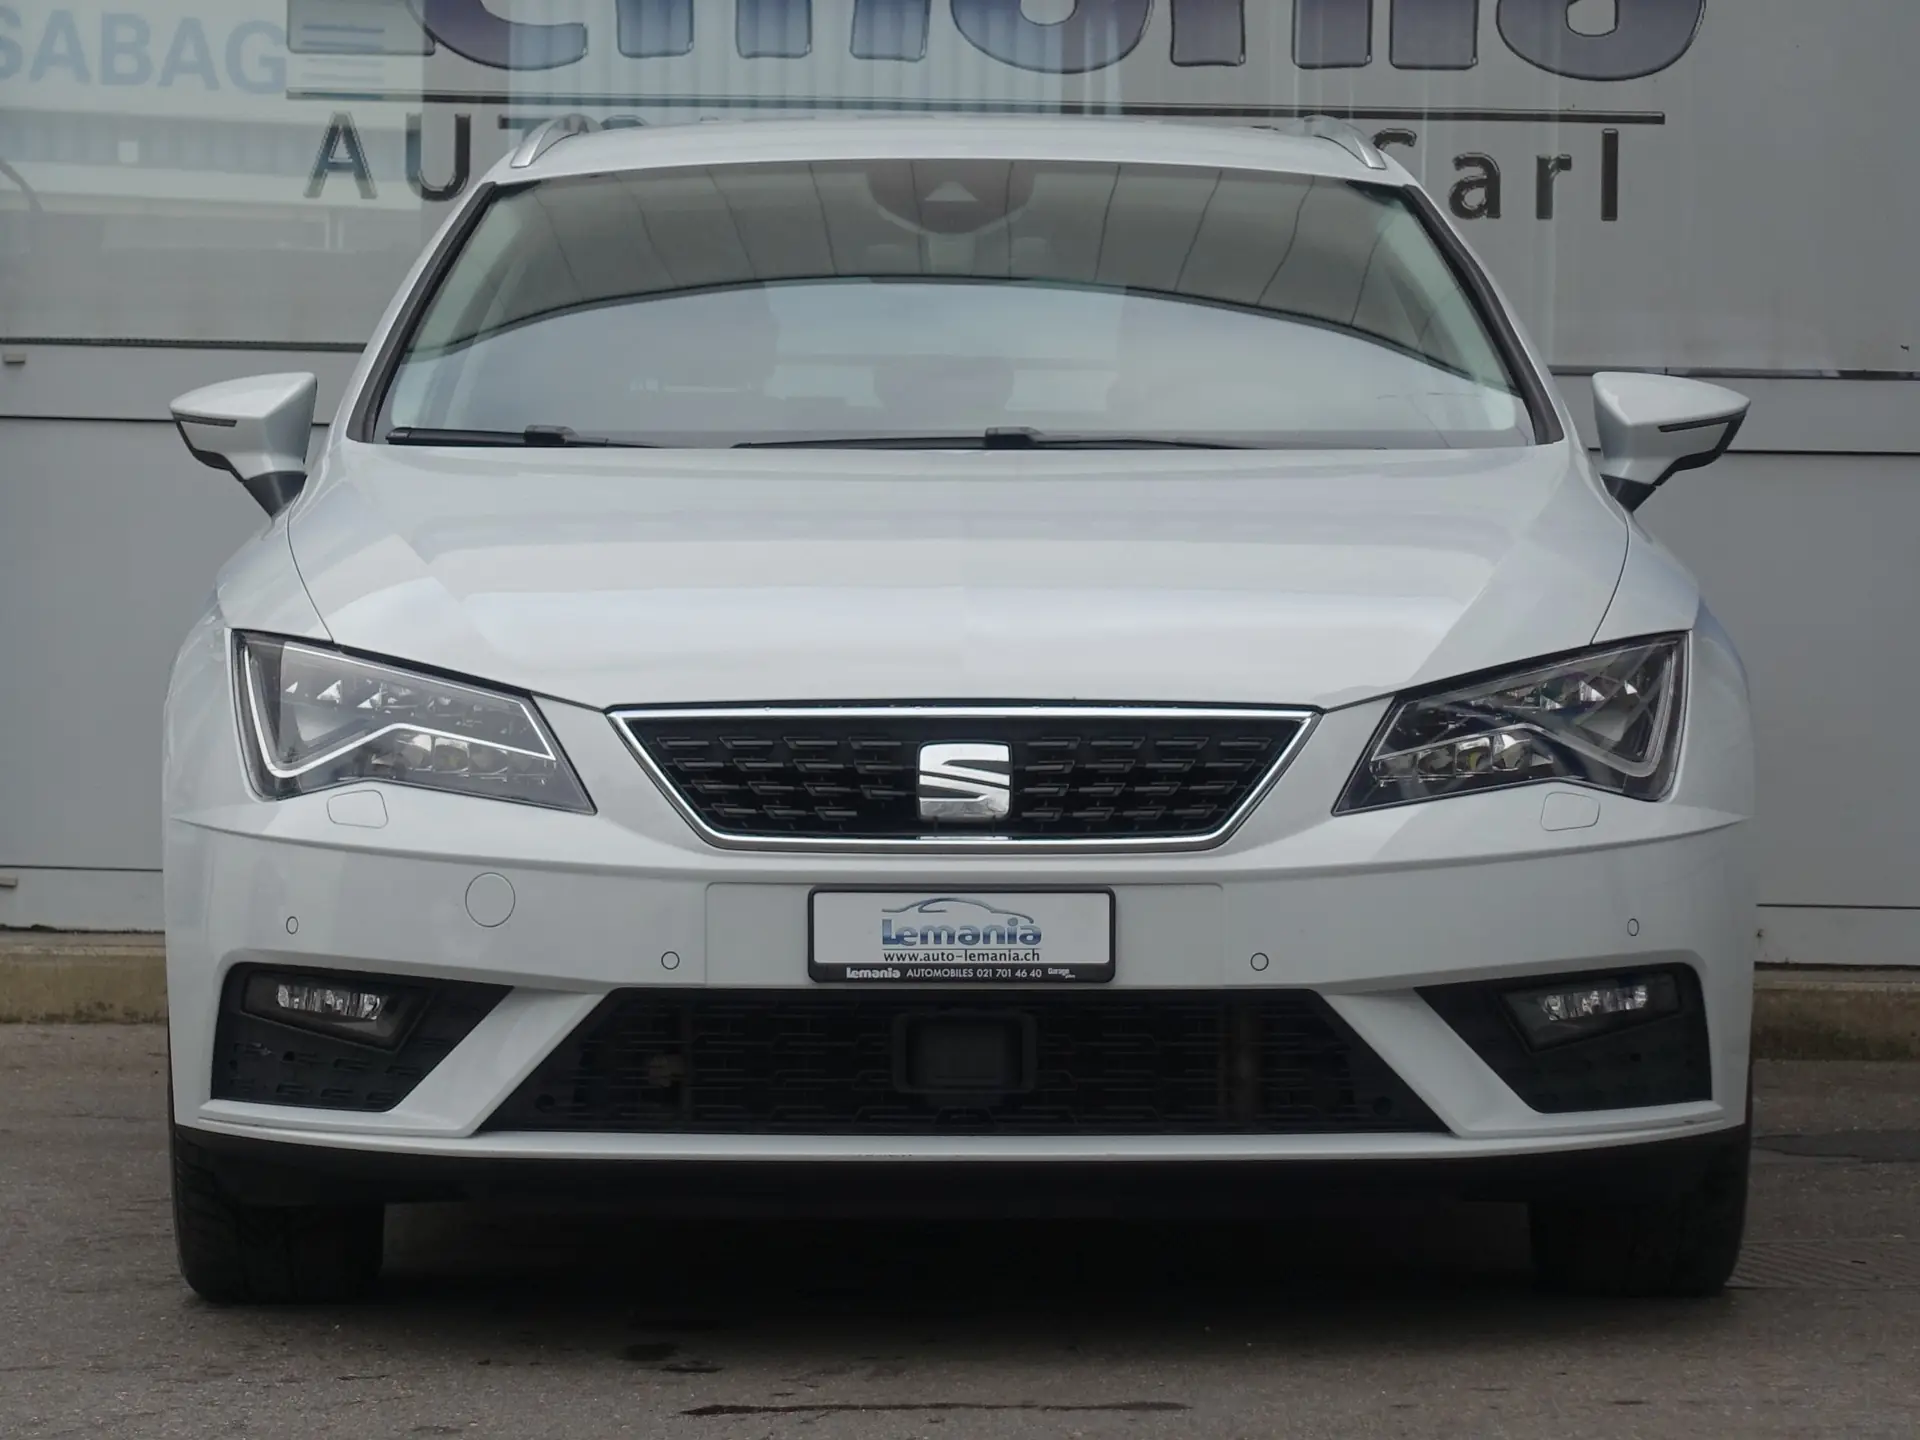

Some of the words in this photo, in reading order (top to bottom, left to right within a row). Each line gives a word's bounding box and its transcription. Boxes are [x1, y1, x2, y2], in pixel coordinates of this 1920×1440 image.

[882, 918, 1042, 946] Lemania
[883, 949, 1041, 962] www.auto-lemania.ch
[906, 968, 974, 978] AUTOMOBILES
[976, 968, 993, 978] 021
[995, 968, 1012, 978] 701
[1014, 968, 1028, 978] 46
[1029, 968, 1042, 978] 40
